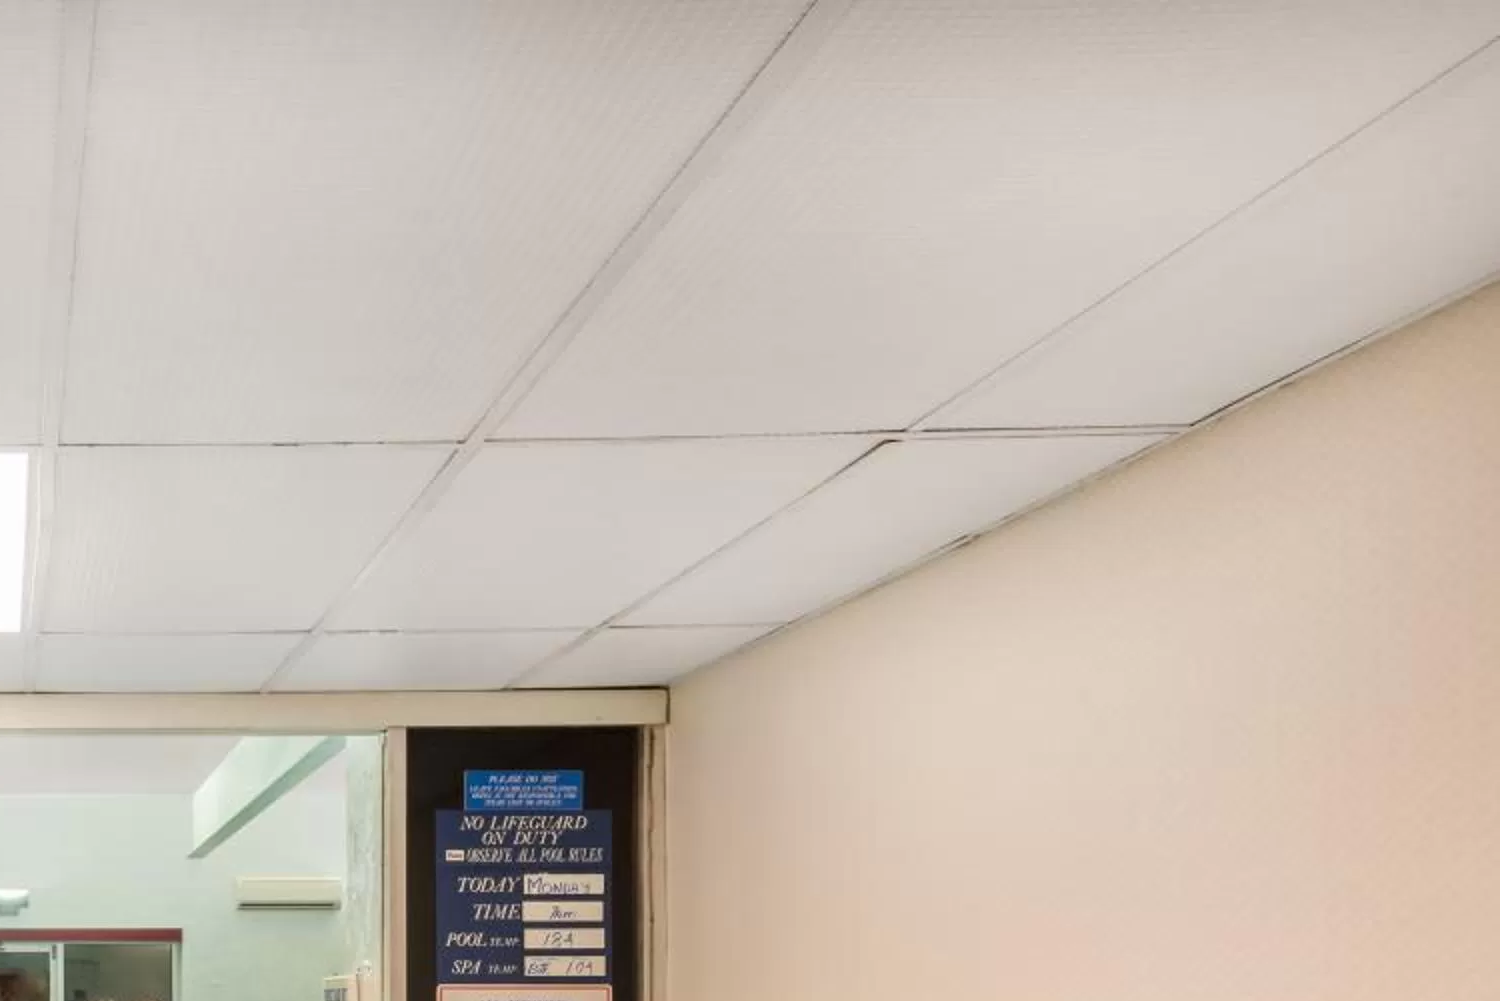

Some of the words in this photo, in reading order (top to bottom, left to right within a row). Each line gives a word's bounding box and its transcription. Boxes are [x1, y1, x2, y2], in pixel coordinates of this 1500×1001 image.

[460, 816, 484, 831] NO
[490, 815, 589, 831] LIFEGUARD
[481, 831, 506, 846] ON
[513, 831, 563, 846] DUTY
[466, 847, 513, 863] OBSERVE
[517, 847, 537, 863] ALL
[540, 847, 566, 863] POOL
[568, 847, 604, 863] RULES
[457, 876, 520, 893] TODAY
[473, 904, 521, 920] TIME
[446, 932, 488, 948] POOL
[451, 960, 482, 975] SPA
